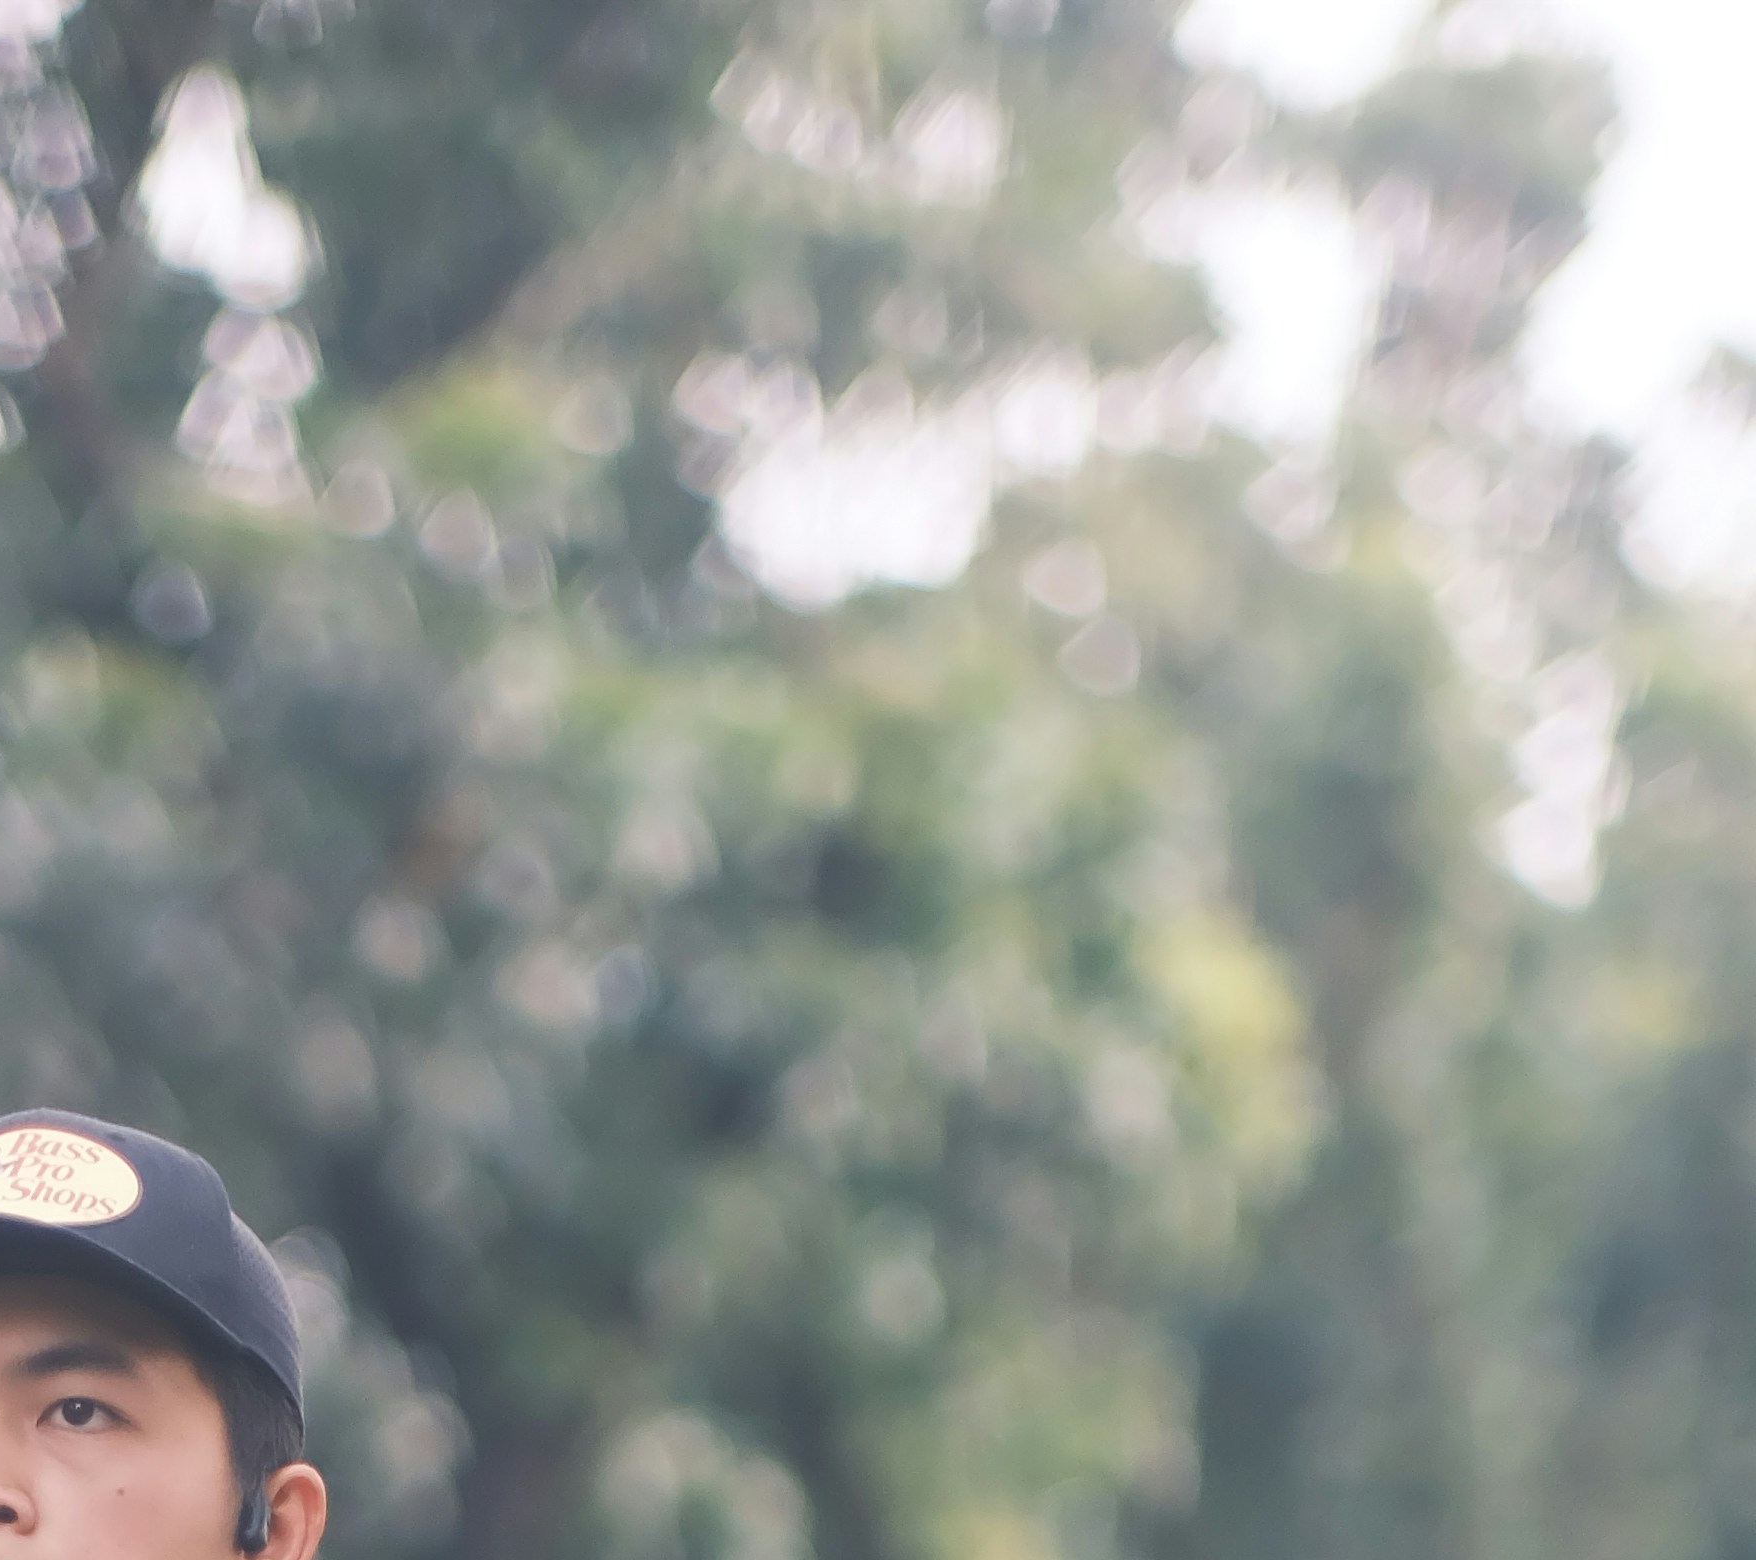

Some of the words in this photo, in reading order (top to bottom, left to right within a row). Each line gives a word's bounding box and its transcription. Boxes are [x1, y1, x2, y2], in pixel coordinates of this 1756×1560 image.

[6, 1132, 103, 1165] Bass
[4, 1154, 75, 1182] Pro
[1, 1177, 117, 1216] Shops
